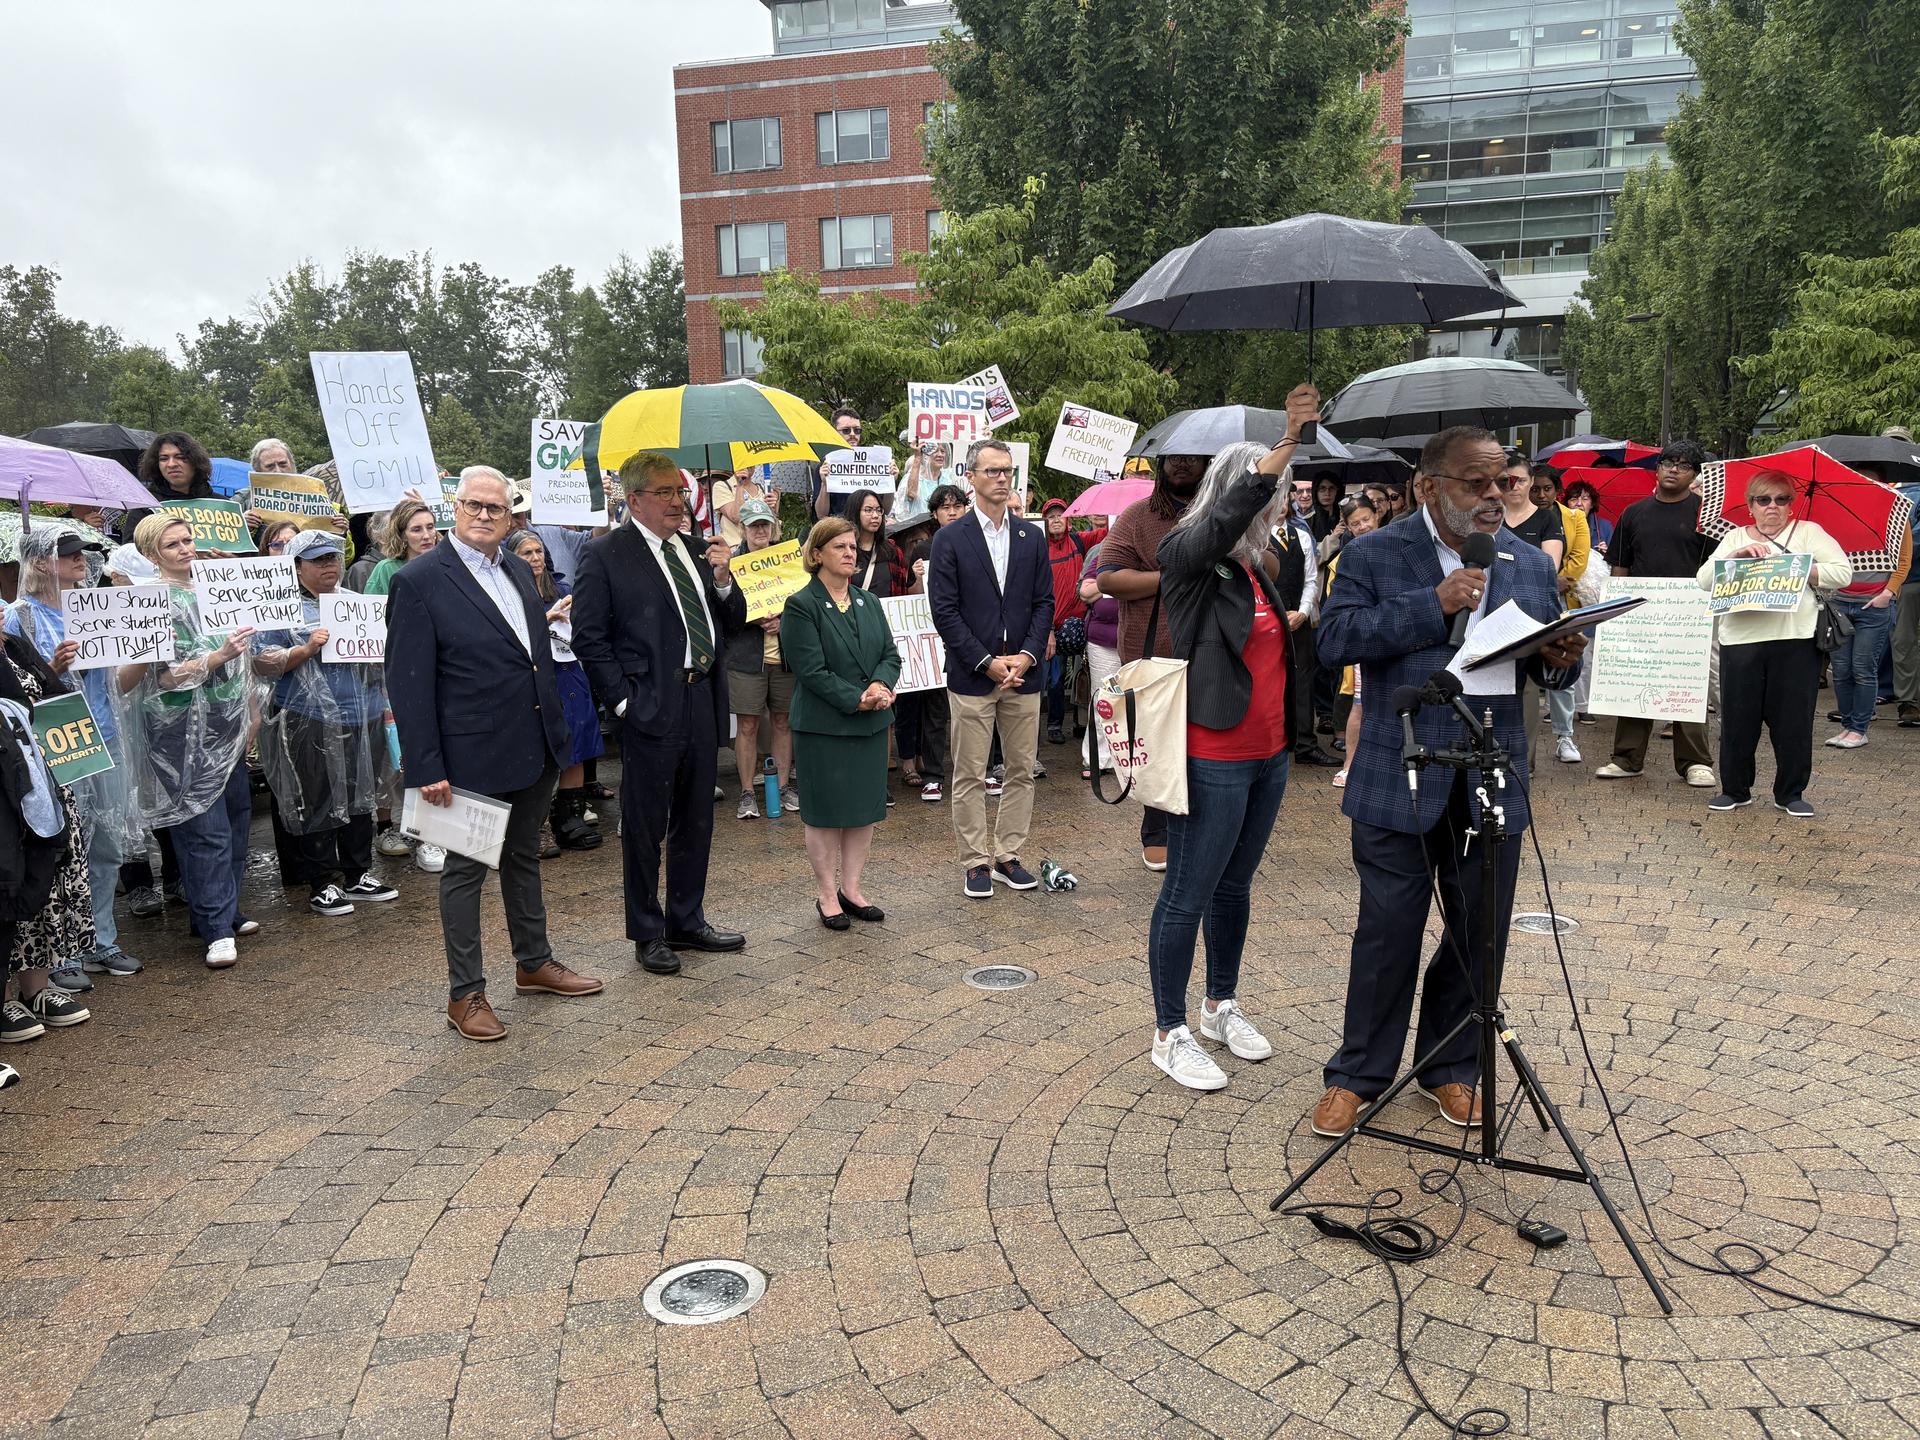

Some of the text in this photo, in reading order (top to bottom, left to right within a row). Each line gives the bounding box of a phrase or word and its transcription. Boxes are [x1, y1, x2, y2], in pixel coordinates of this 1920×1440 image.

[319, 361, 404, 404] Hands
[910, 388, 985, 411] HANDS
[344, 408, 400, 447] Off
[915, 413, 977, 440] OFF!
[1089, 414, 1136, 438] SUPPORT
[1066, 428, 1114, 452] ACADEMIC
[854, 451, 867, 461] NO
[1061, 446, 1108, 469] FREEDOM
[352, 455, 426, 490] GMU
[560, 471, 572, 479] and
[830, 464, 890, 475] CONFIDENCE
[253, 498, 287, 512] BOARD
[289, 501, 300, 514] OF
[193, 508, 244, 528] BOARD
[215, 525, 240, 543] GO!
[750, 554, 781, 572] GMU
[782, 546, 803, 563] and
[193, 561, 294, 588] Have Integrity
[1712, 581, 1741, 598] BAD
[1739, 576, 1767, 593] FOR
[1767, 575, 1805, 592] GMU
[67, 590, 170, 615] GMU Should
[334, 600, 367, 622] GMU
[1709, 591, 1799, 611] BAD FOR VIRGINIA
[203, 602, 302, 629] NOT TRUMP!
[355, 623, 367, 638] IS
[110, 629, 171, 661] TRUMP!
[45, 717, 95, 754] OFF
